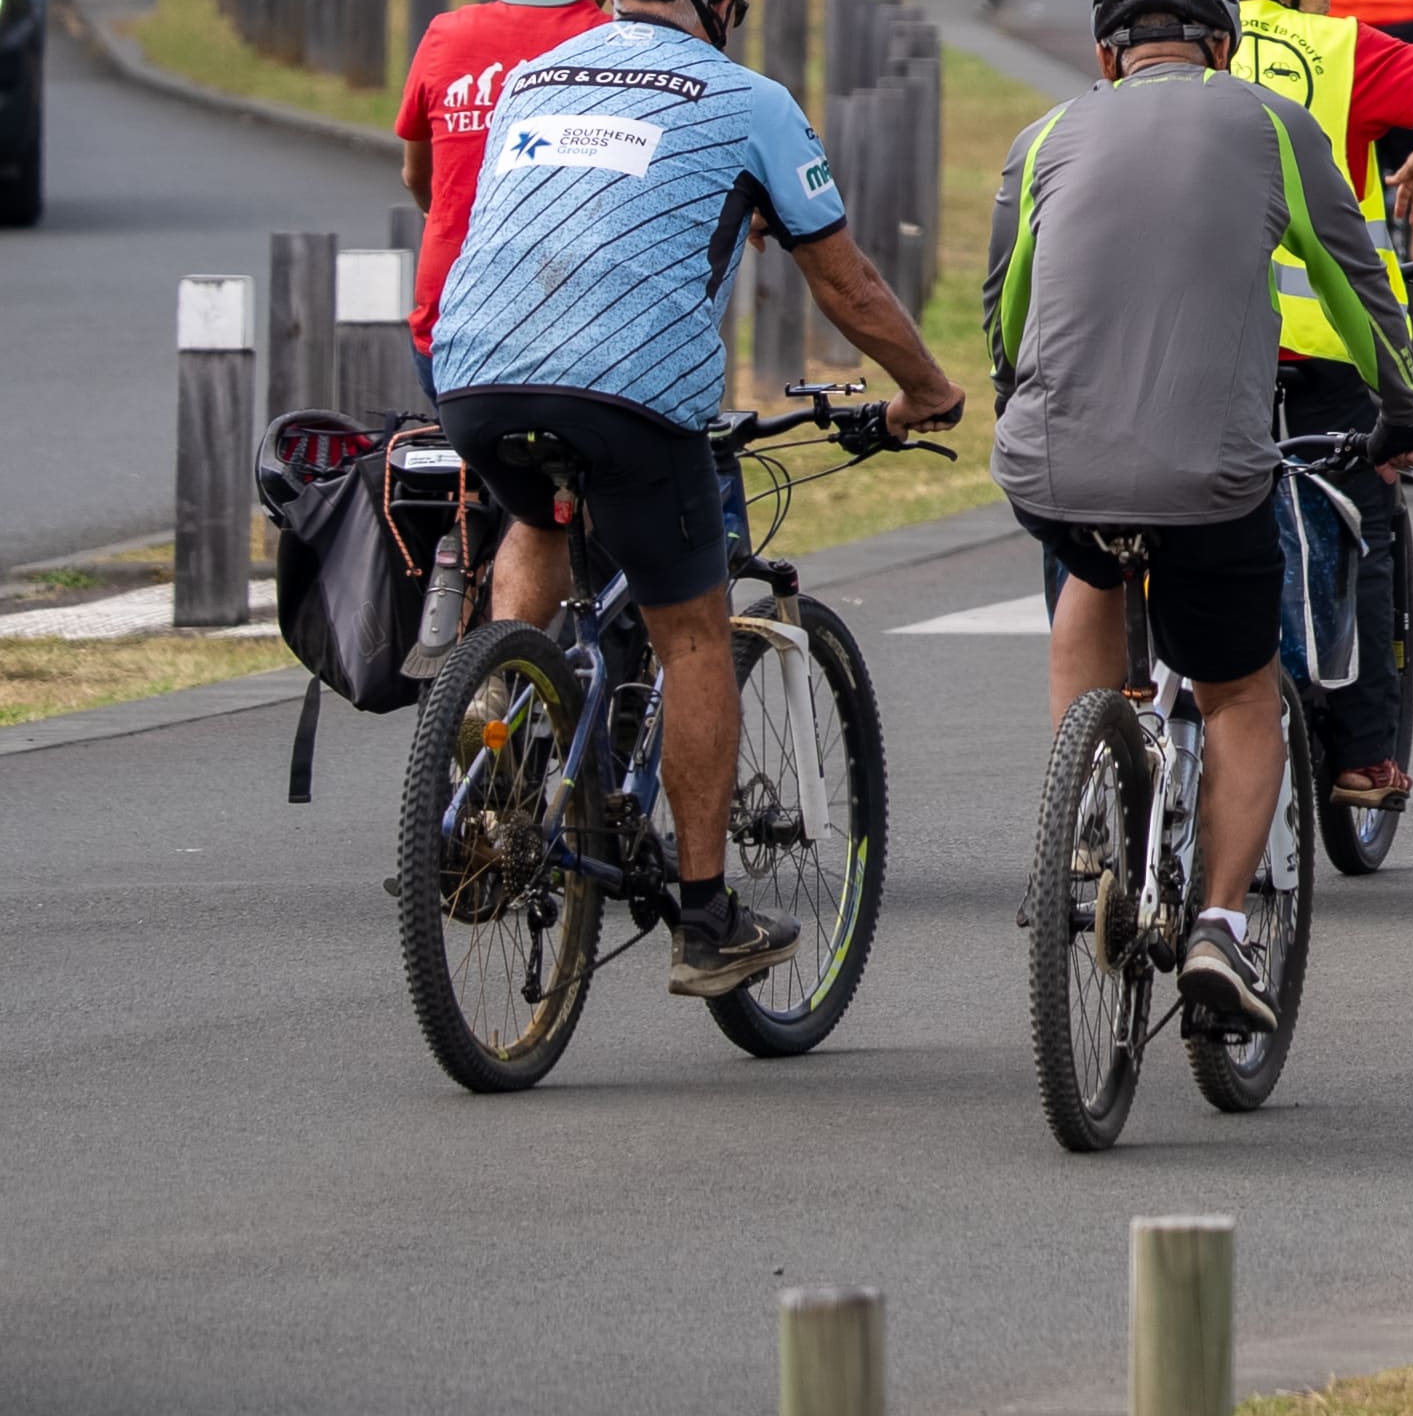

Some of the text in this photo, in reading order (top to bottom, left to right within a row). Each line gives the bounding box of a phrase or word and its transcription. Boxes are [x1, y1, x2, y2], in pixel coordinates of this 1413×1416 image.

[1290, 33, 1325, 76] route
[513, 69, 702, 97] BANG & OLUFSEN
[559, 136, 610, 148] CROSS
[562, 127, 648, 147] SOUTHERN
[556, 146, 598, 156] Group
